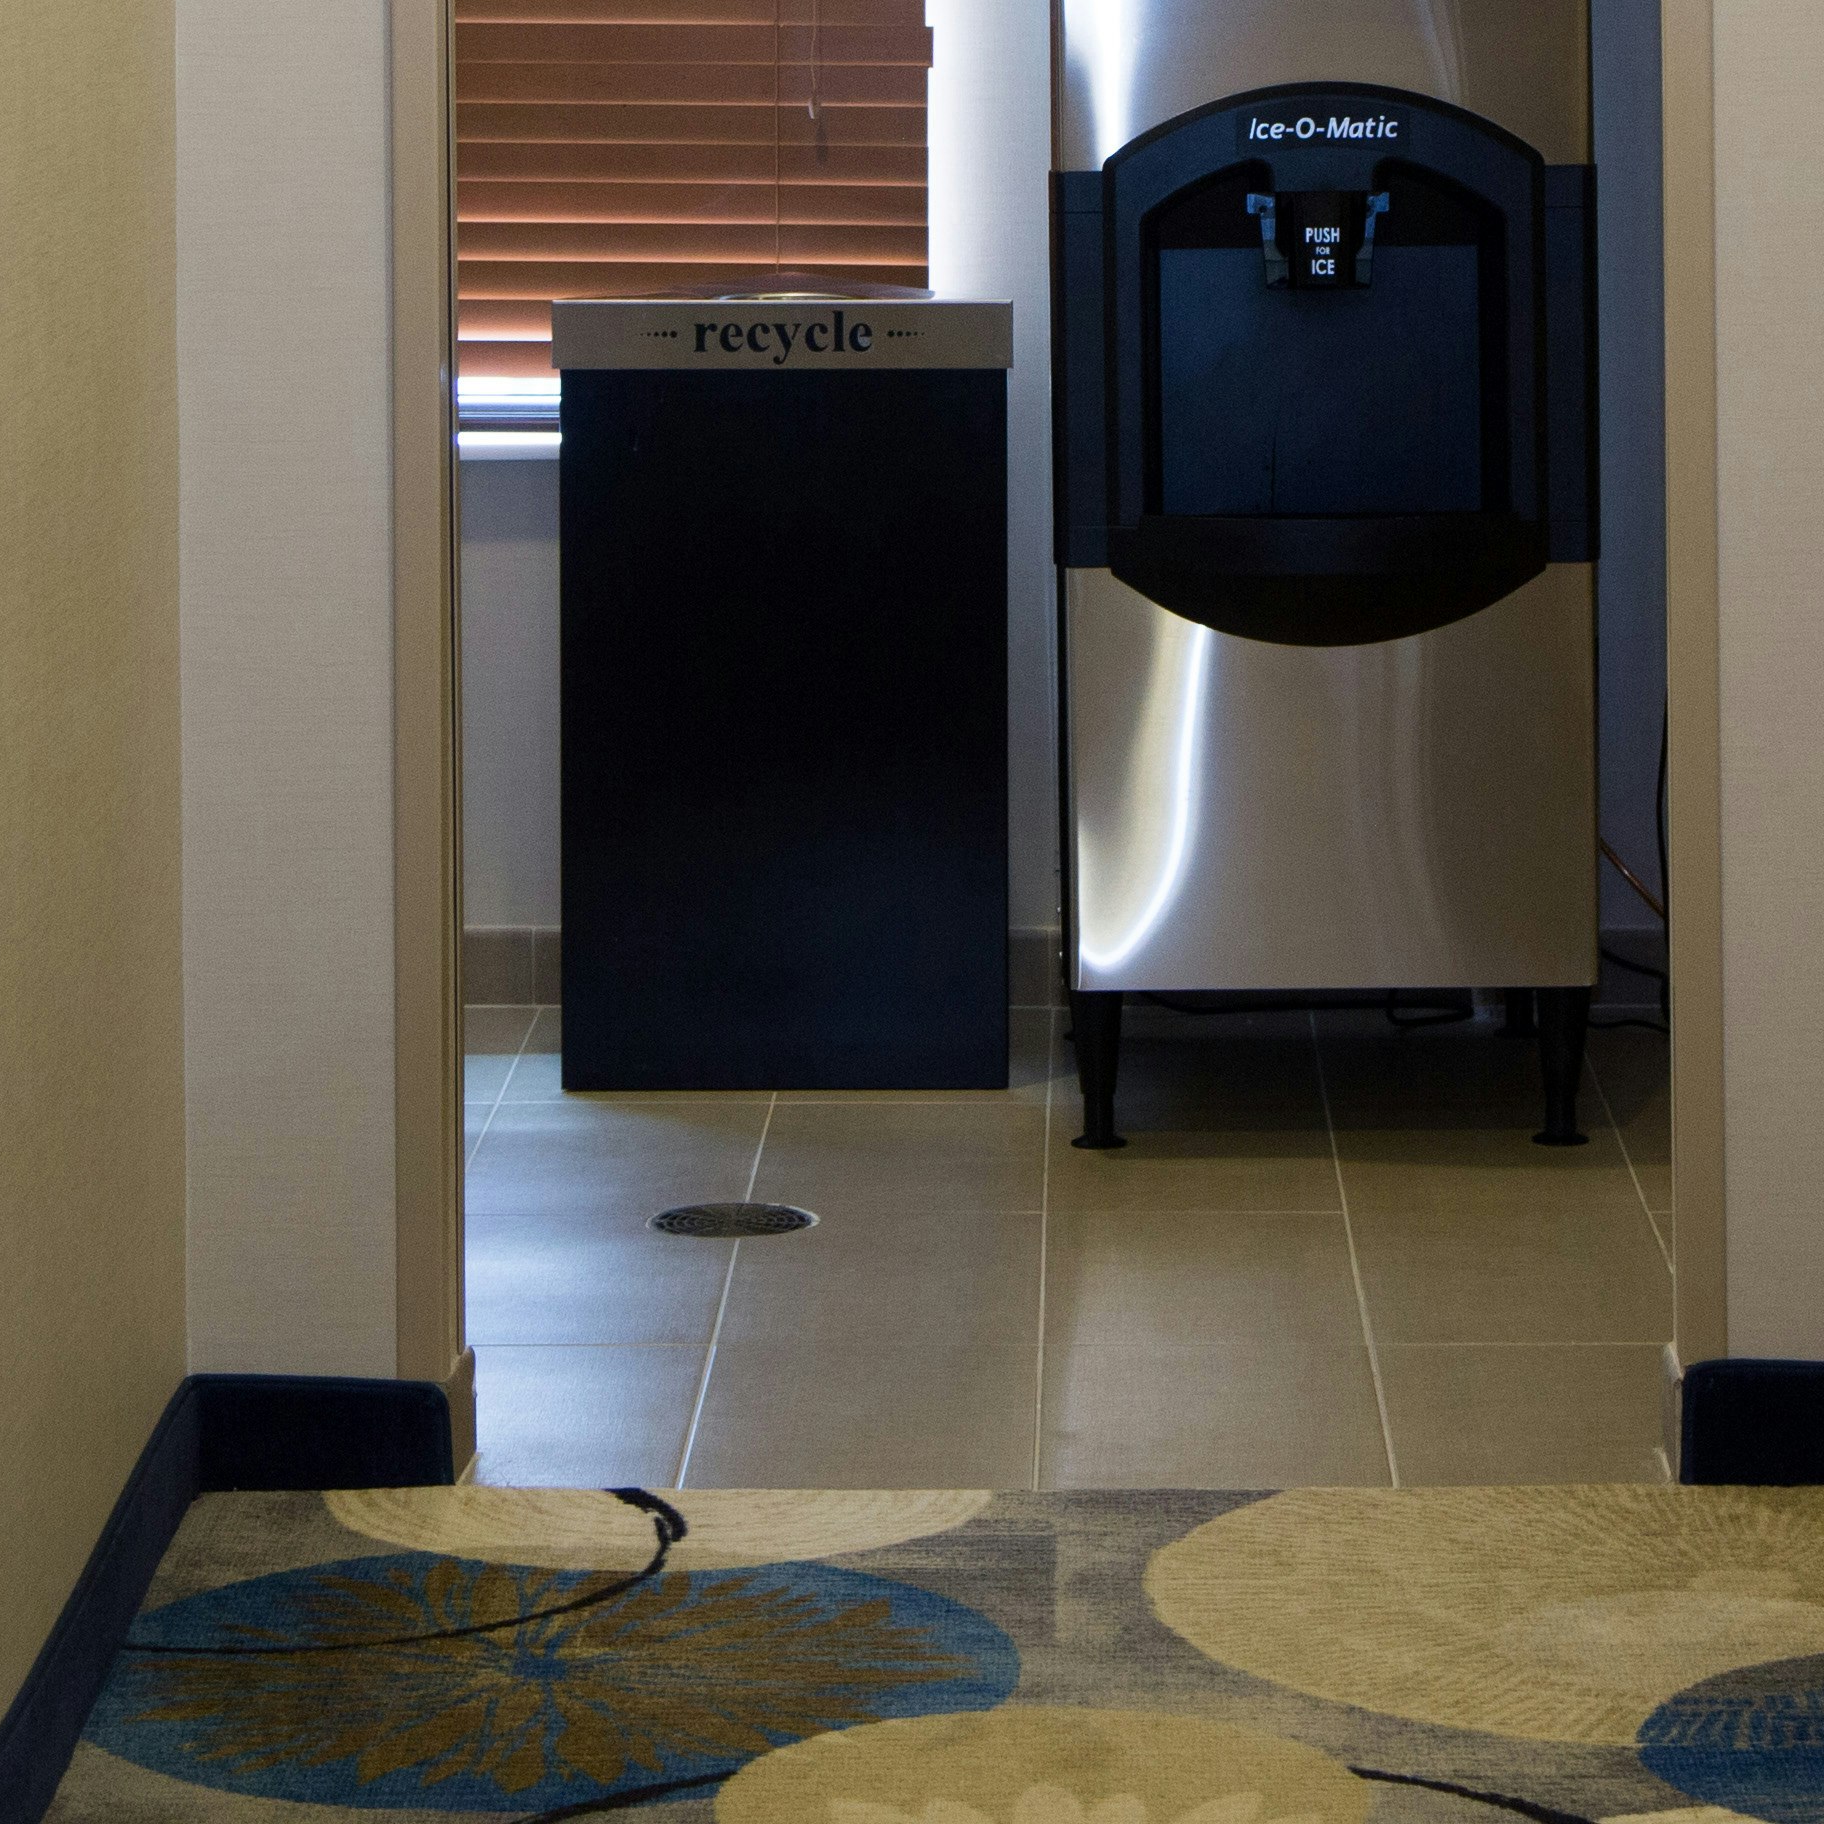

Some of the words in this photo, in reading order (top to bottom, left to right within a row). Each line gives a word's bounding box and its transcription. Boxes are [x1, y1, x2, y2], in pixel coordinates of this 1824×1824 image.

[1249, 115, 1398, 139] Ice-O-Matic
[1305, 227, 1340, 243] PUSH
[1316, 246, 1330, 255] FOR
[1311, 259, 1335, 275] ICE
[694, 310, 873, 365] recycle
